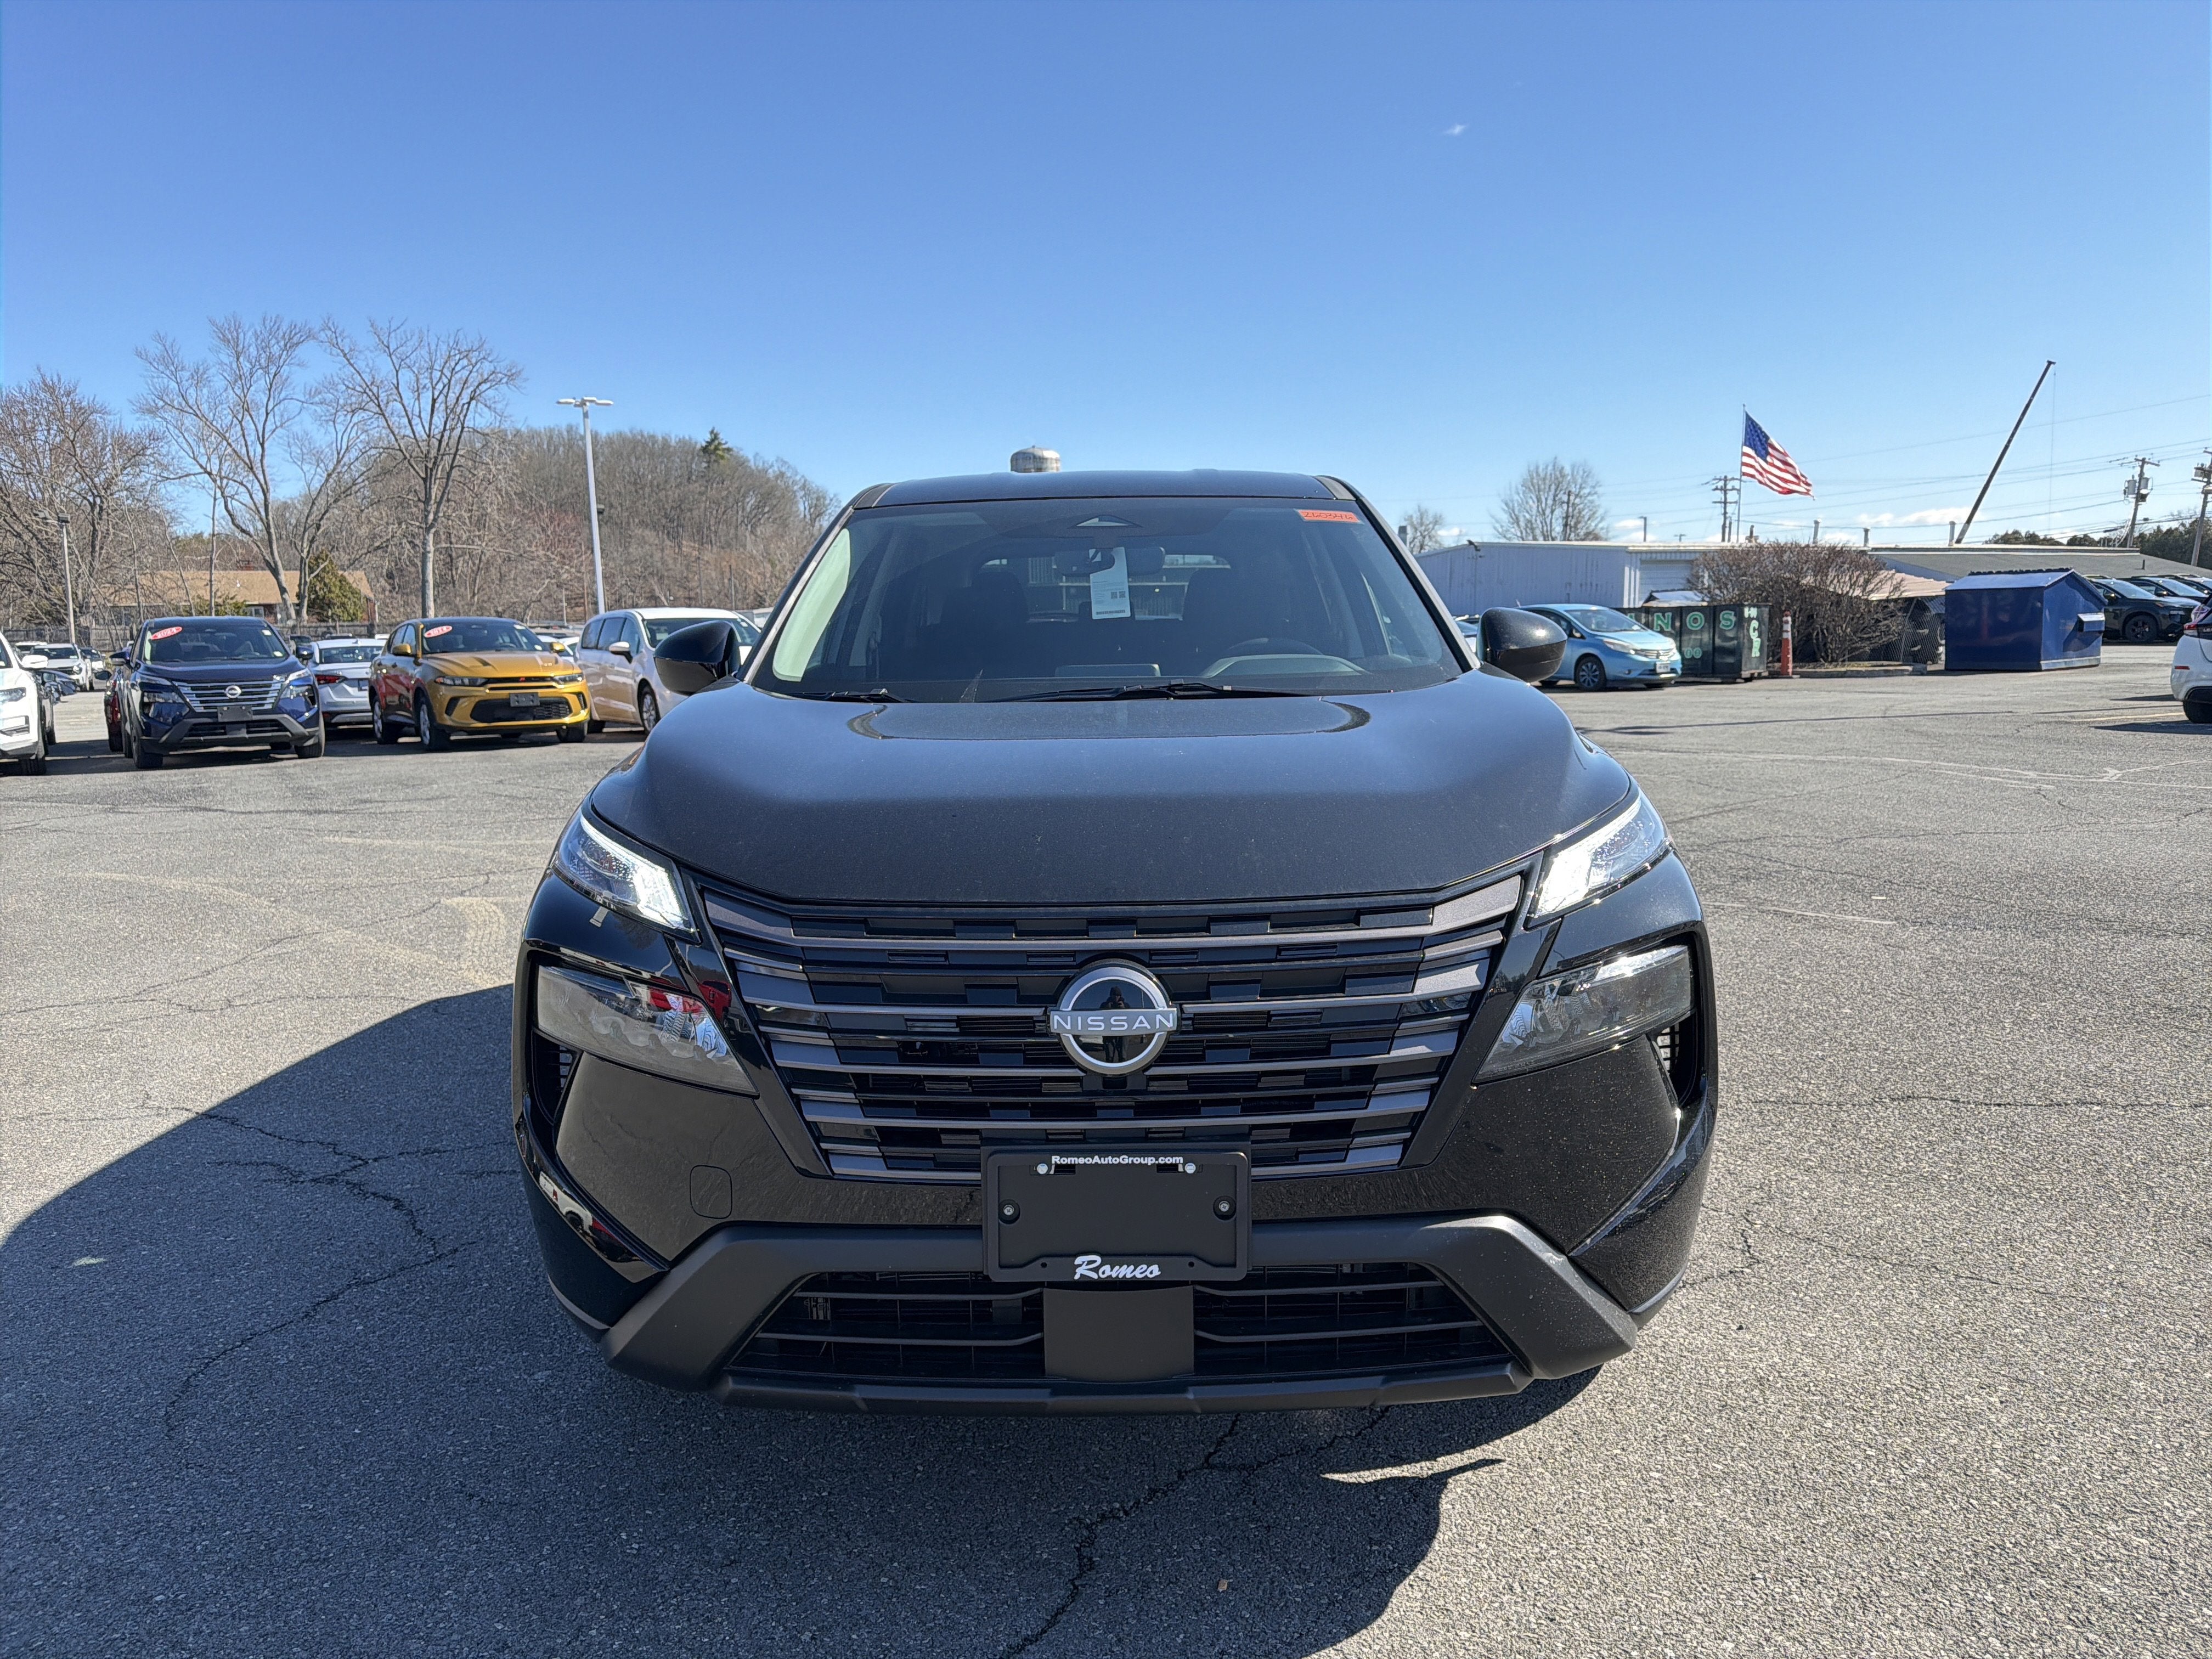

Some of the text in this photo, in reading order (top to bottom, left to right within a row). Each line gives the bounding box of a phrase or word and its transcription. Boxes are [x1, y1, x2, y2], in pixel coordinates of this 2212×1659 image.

[1053, 1013, 1173, 1030] NISSAN
[1051, 1155, 1183, 1166] RomeoAutoGroup.com
[1074, 1255, 1161, 1280] Romeo
